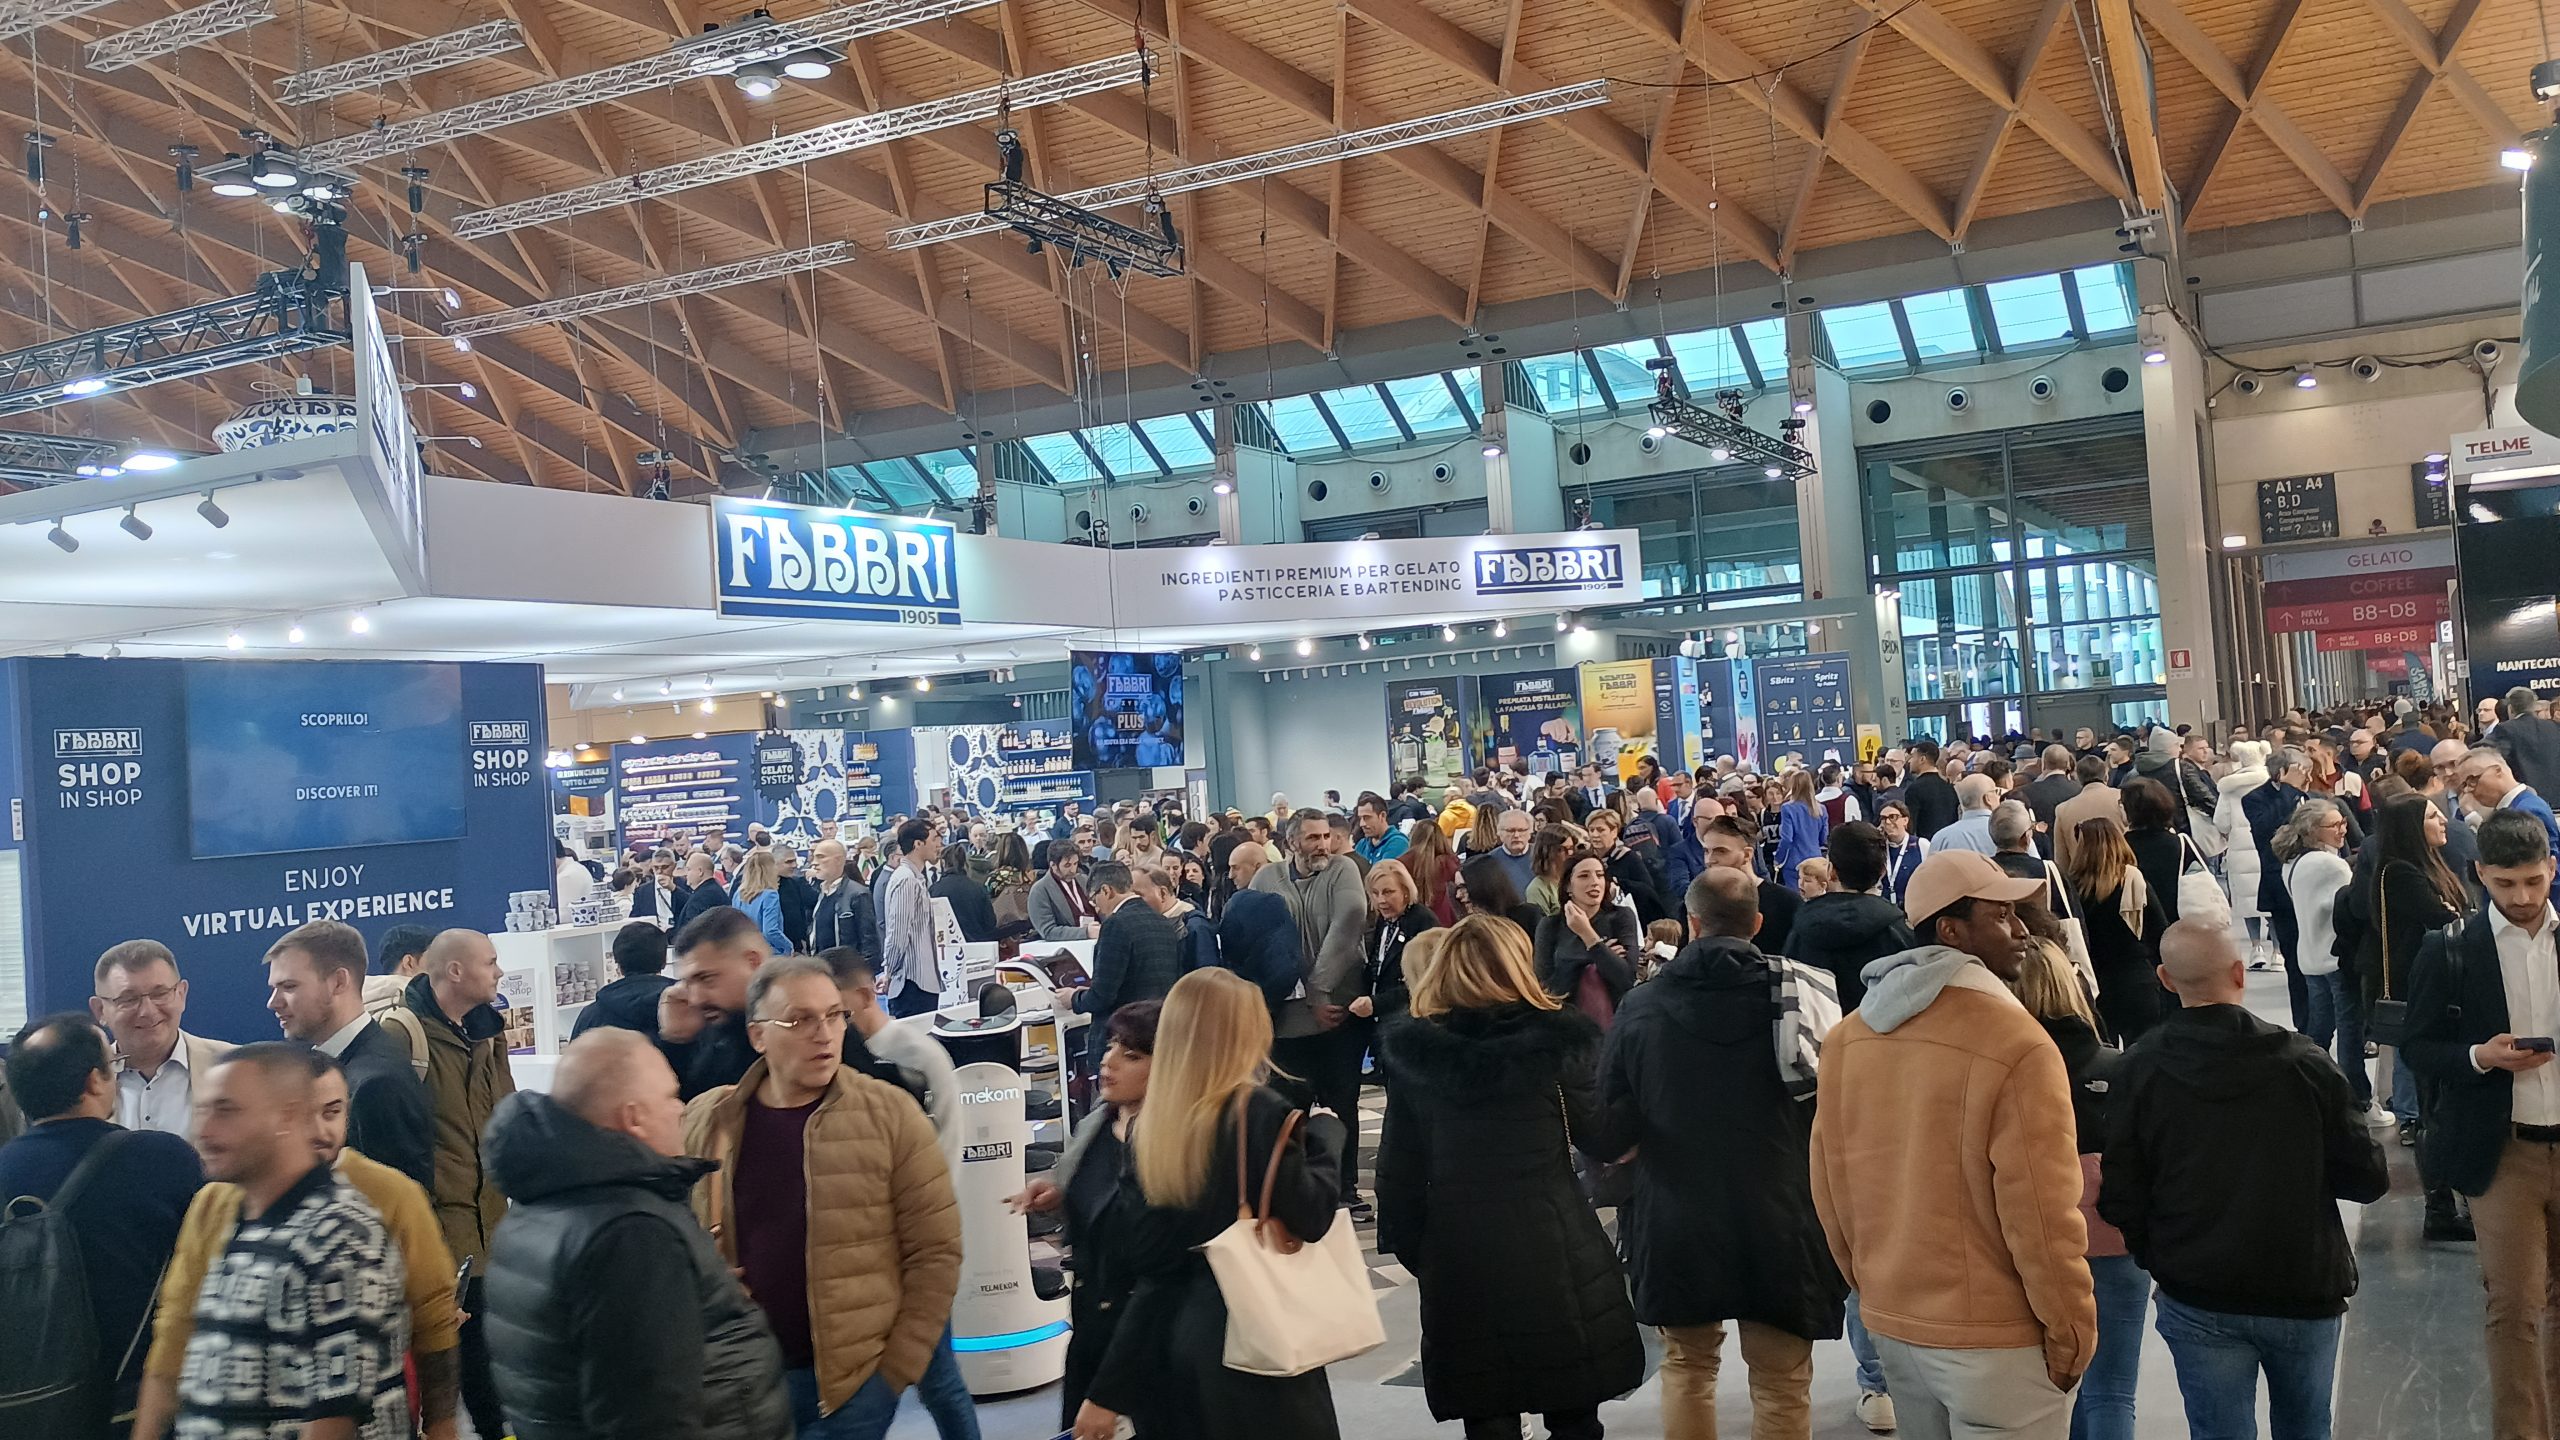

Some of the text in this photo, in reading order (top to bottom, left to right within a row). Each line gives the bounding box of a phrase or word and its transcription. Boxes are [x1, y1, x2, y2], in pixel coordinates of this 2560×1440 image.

[2465, 437, 2531, 455] TELME
[2276, 481, 2292, 494] A1
[2305, 477, 2323, 491] A4
[2292, 495, 2301, 507] D
[724, 513, 953, 603] FABBRI
[1479, 548, 1619, 584] FABBRI
[2347, 550, 2413, 568] GELATO
[1161, 560, 1461, 586] INGREDIENTI PREMIUM PER GELATO
[1219, 578, 1462, 602] PASTICCERIA E BARTENDING
[1583, 583, 1607, 591] 1905
[2350, 576, 2416, 595] COFFEE
[901, 609, 937, 625] 1905
[2301, 602, 2417, 621] NEW B8-D8
[2301, 617, 2330, 626] HALLS
[2374, 631, 2418, 644] B8-D8
[1109, 677, 1151, 692] FABBRI
[1516, 680, 1552, 691] FABBRI
[1505, 704, 1536, 713] FAMIGLIA
[300, 713, 368, 727] SCOPRILO!
[1117, 714, 1145, 729] PLUS
[473, 724, 526, 739] FABBRI
[58, 732, 138, 750] FABBRI
[472, 749, 530, 770] SHOP
[58, 762, 141, 788] SHOP
[761, 765, 794, 775] GELATO
[474, 772, 530, 787] IN SHOP
[760, 774, 795, 785] SYSTEM
[60, 789, 142, 808] IN SHOP
[296, 784, 378, 800] DISCOVER IT!
[285, 864, 365, 892] ENJOY
[183, 888, 454, 937] VIRTUAL EXPERIENCE
[510, 986, 532, 996] Shop
[960, 1086, 1019, 1105] mekom
